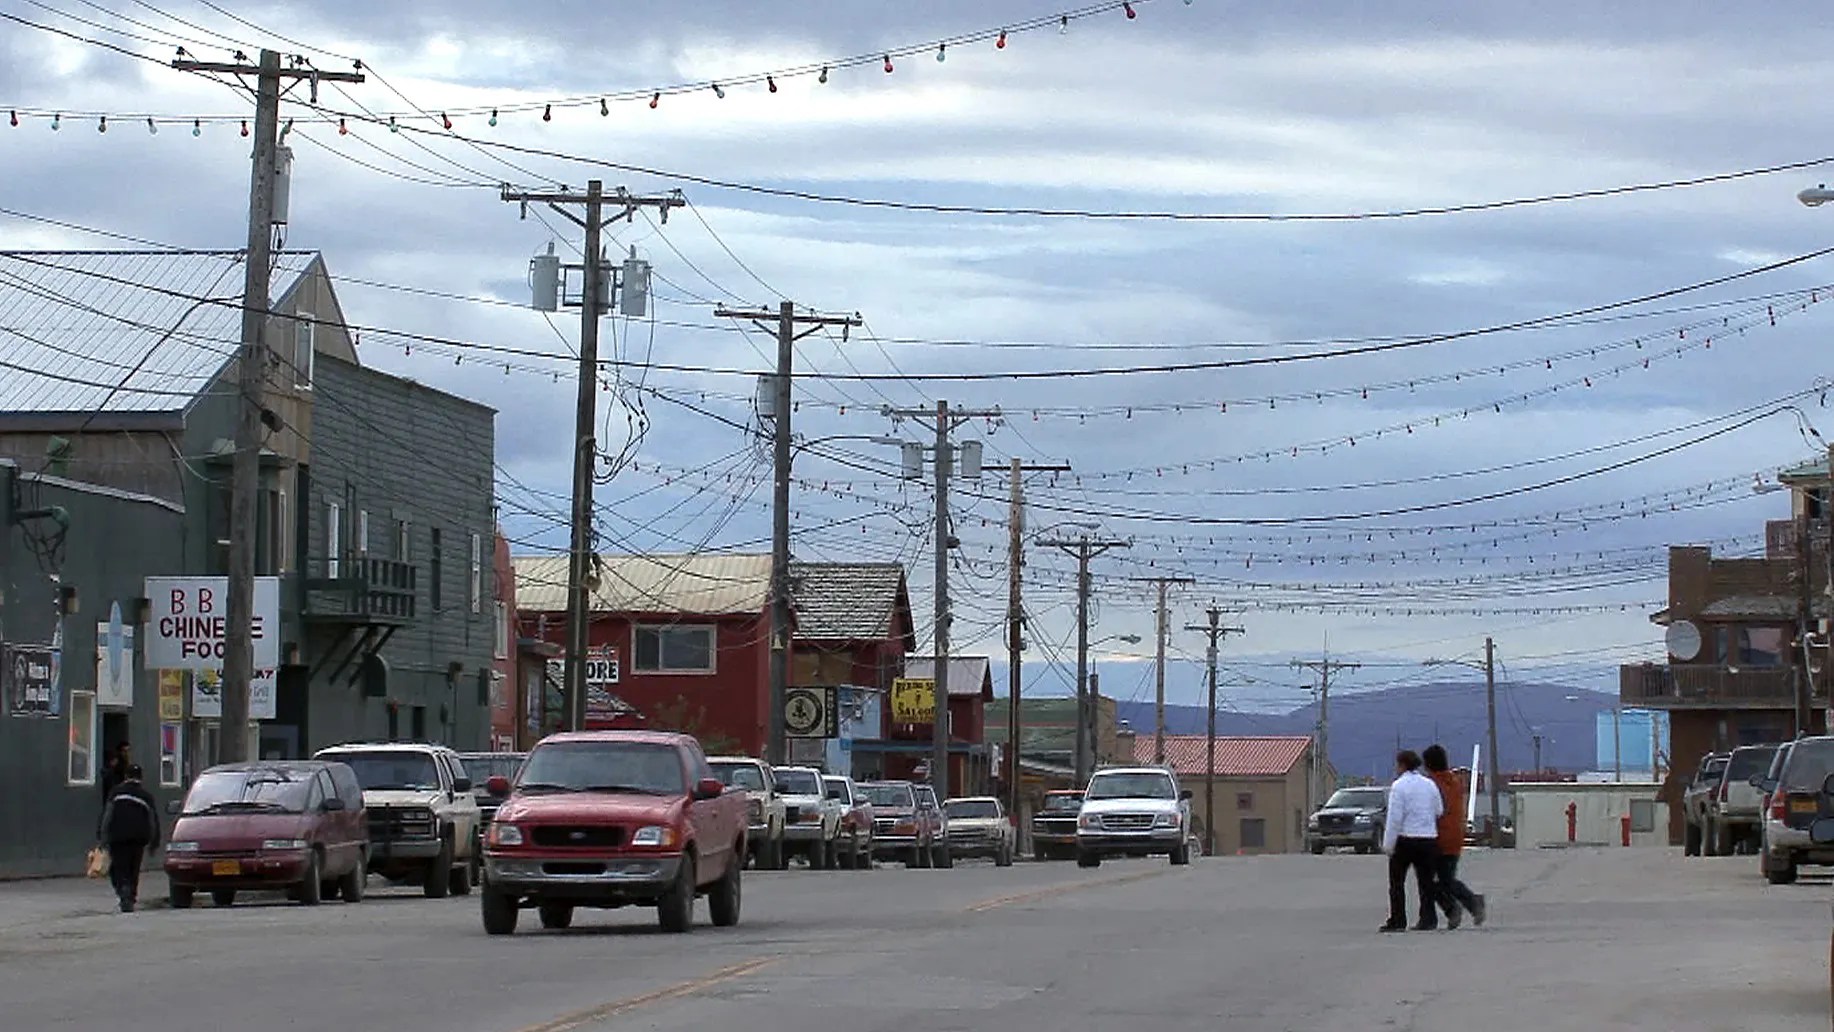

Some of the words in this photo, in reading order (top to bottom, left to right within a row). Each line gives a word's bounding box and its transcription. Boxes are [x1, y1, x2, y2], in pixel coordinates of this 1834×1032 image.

[171, 589, 185, 614] B
[198, 588, 212, 613] B
[160, 617, 263, 639] CHINEE
[182, 642, 225, 659] FOO
[586, 662, 617, 679] ORE
